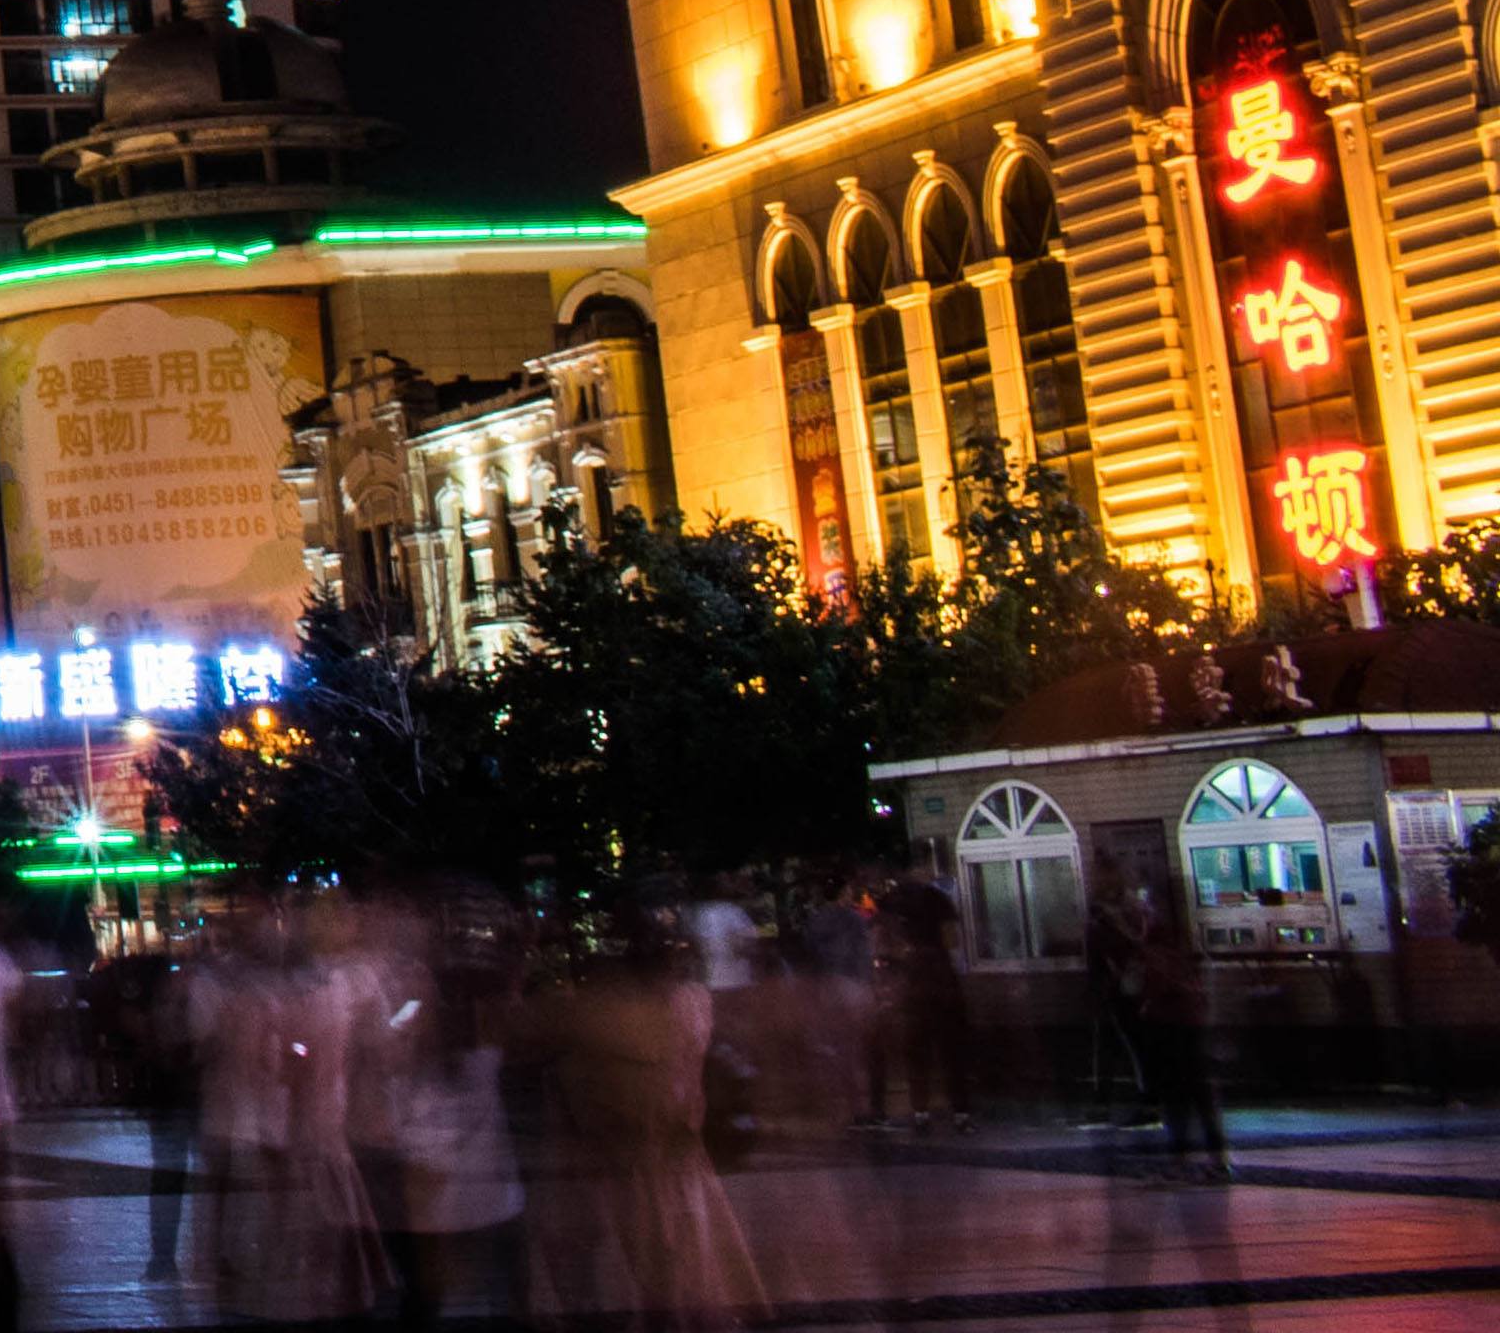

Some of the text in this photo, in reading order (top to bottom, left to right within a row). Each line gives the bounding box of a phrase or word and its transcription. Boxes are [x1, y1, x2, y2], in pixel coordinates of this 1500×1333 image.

[1224, 79, 1377, 565] 曼哈顿
[35, 346, 250, 408] 孕婴童用品
[55, 400, 232, 459] 购物广场
